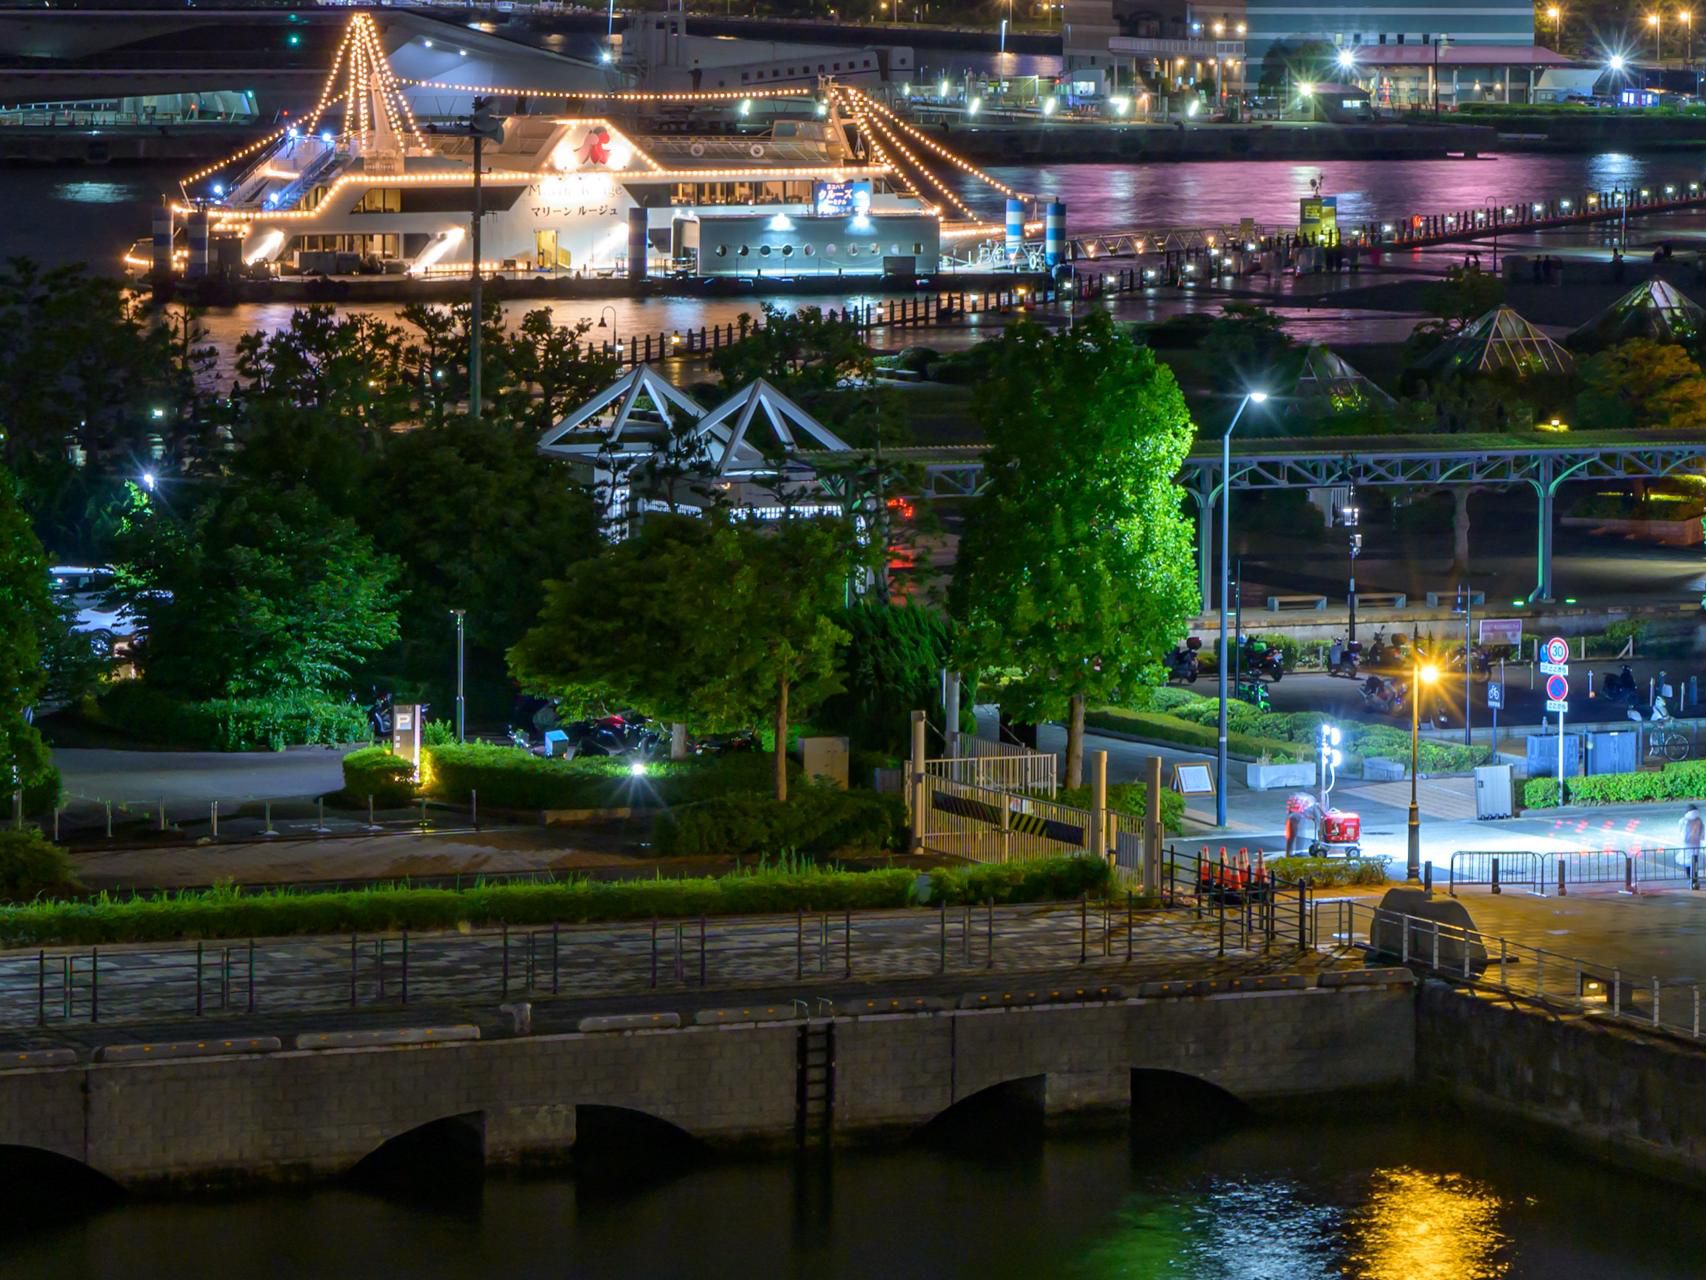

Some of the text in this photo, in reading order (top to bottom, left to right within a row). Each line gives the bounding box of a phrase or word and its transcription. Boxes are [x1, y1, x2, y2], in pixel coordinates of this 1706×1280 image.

[531, 205, 619, 217] マリーン ルージュ
[1552, 645, 1564, 658] 30
